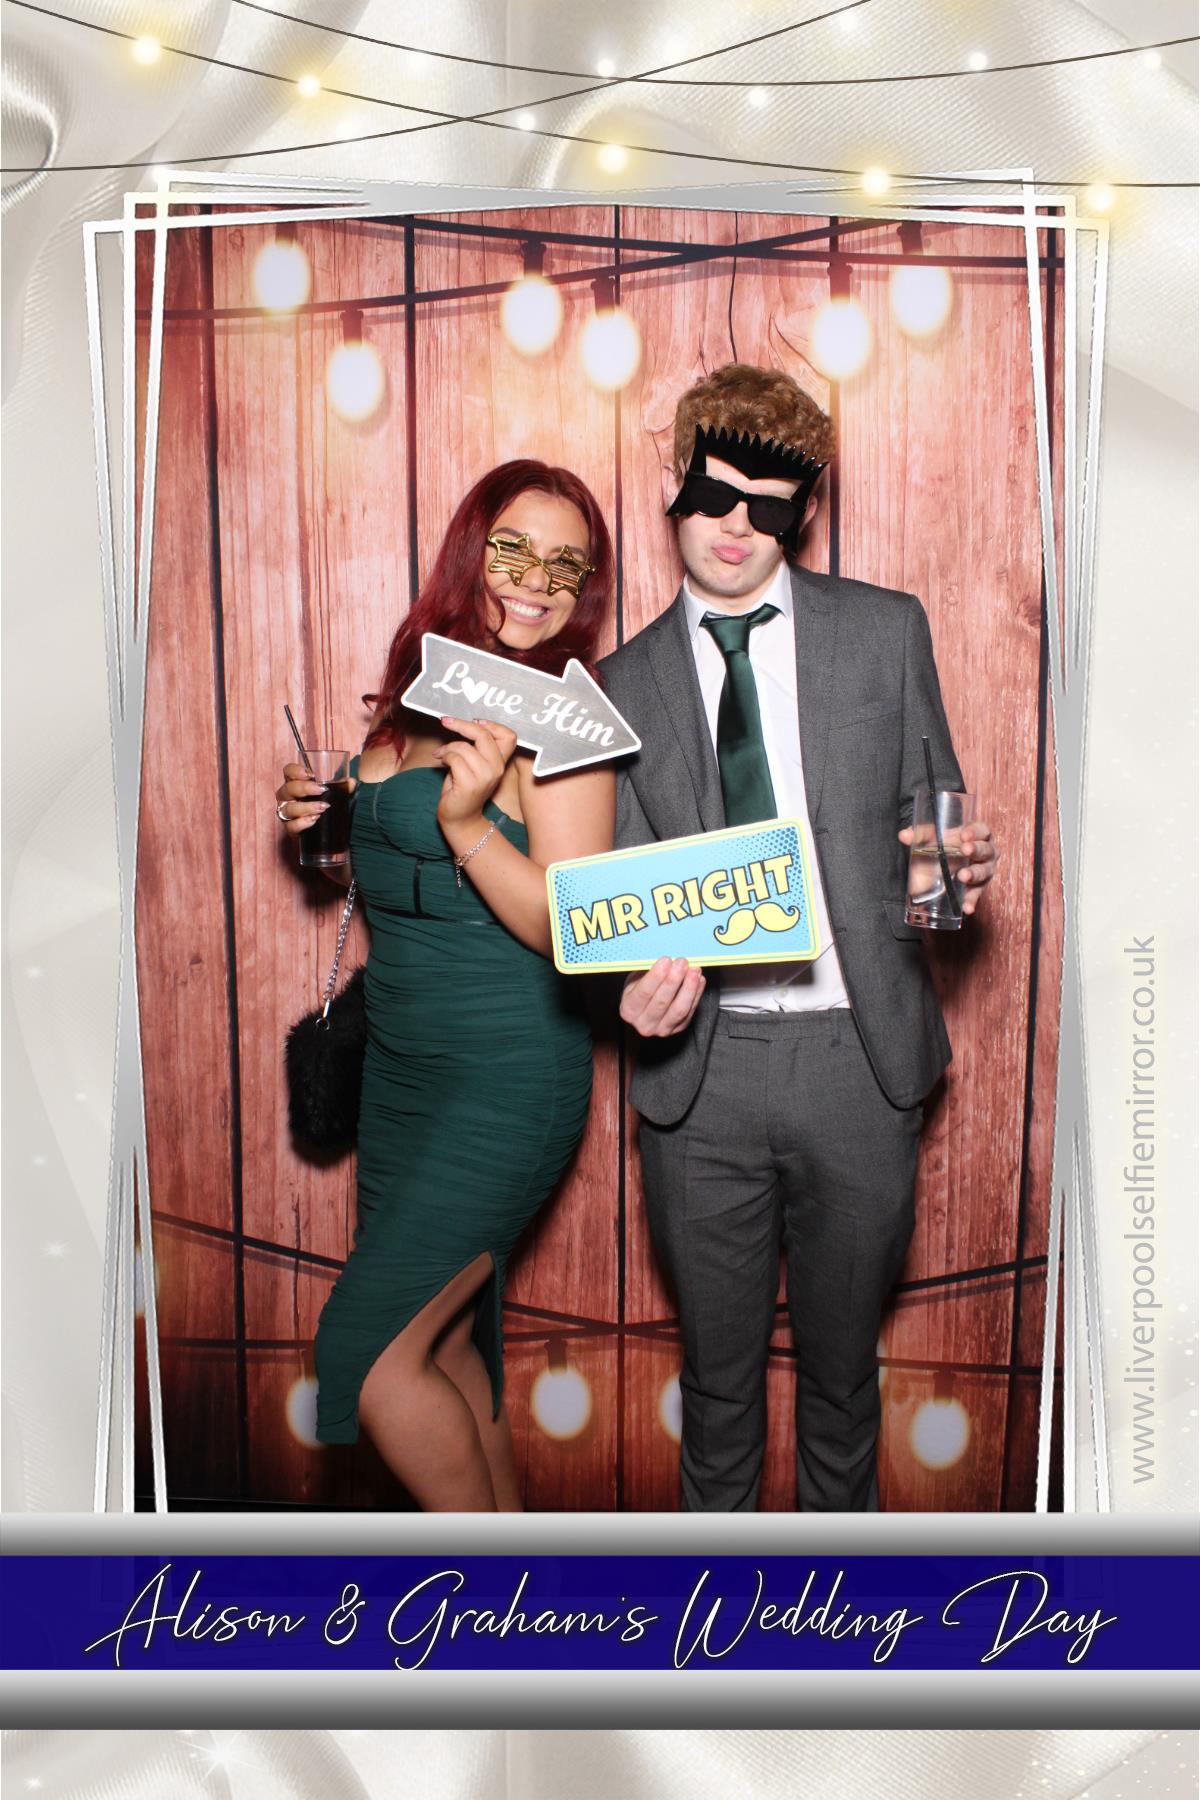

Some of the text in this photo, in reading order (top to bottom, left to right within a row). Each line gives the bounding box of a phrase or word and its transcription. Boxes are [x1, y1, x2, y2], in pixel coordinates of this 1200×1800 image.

[532, 693, 614, 746] Him
[568, 854, 793, 946] MR RIGHT
